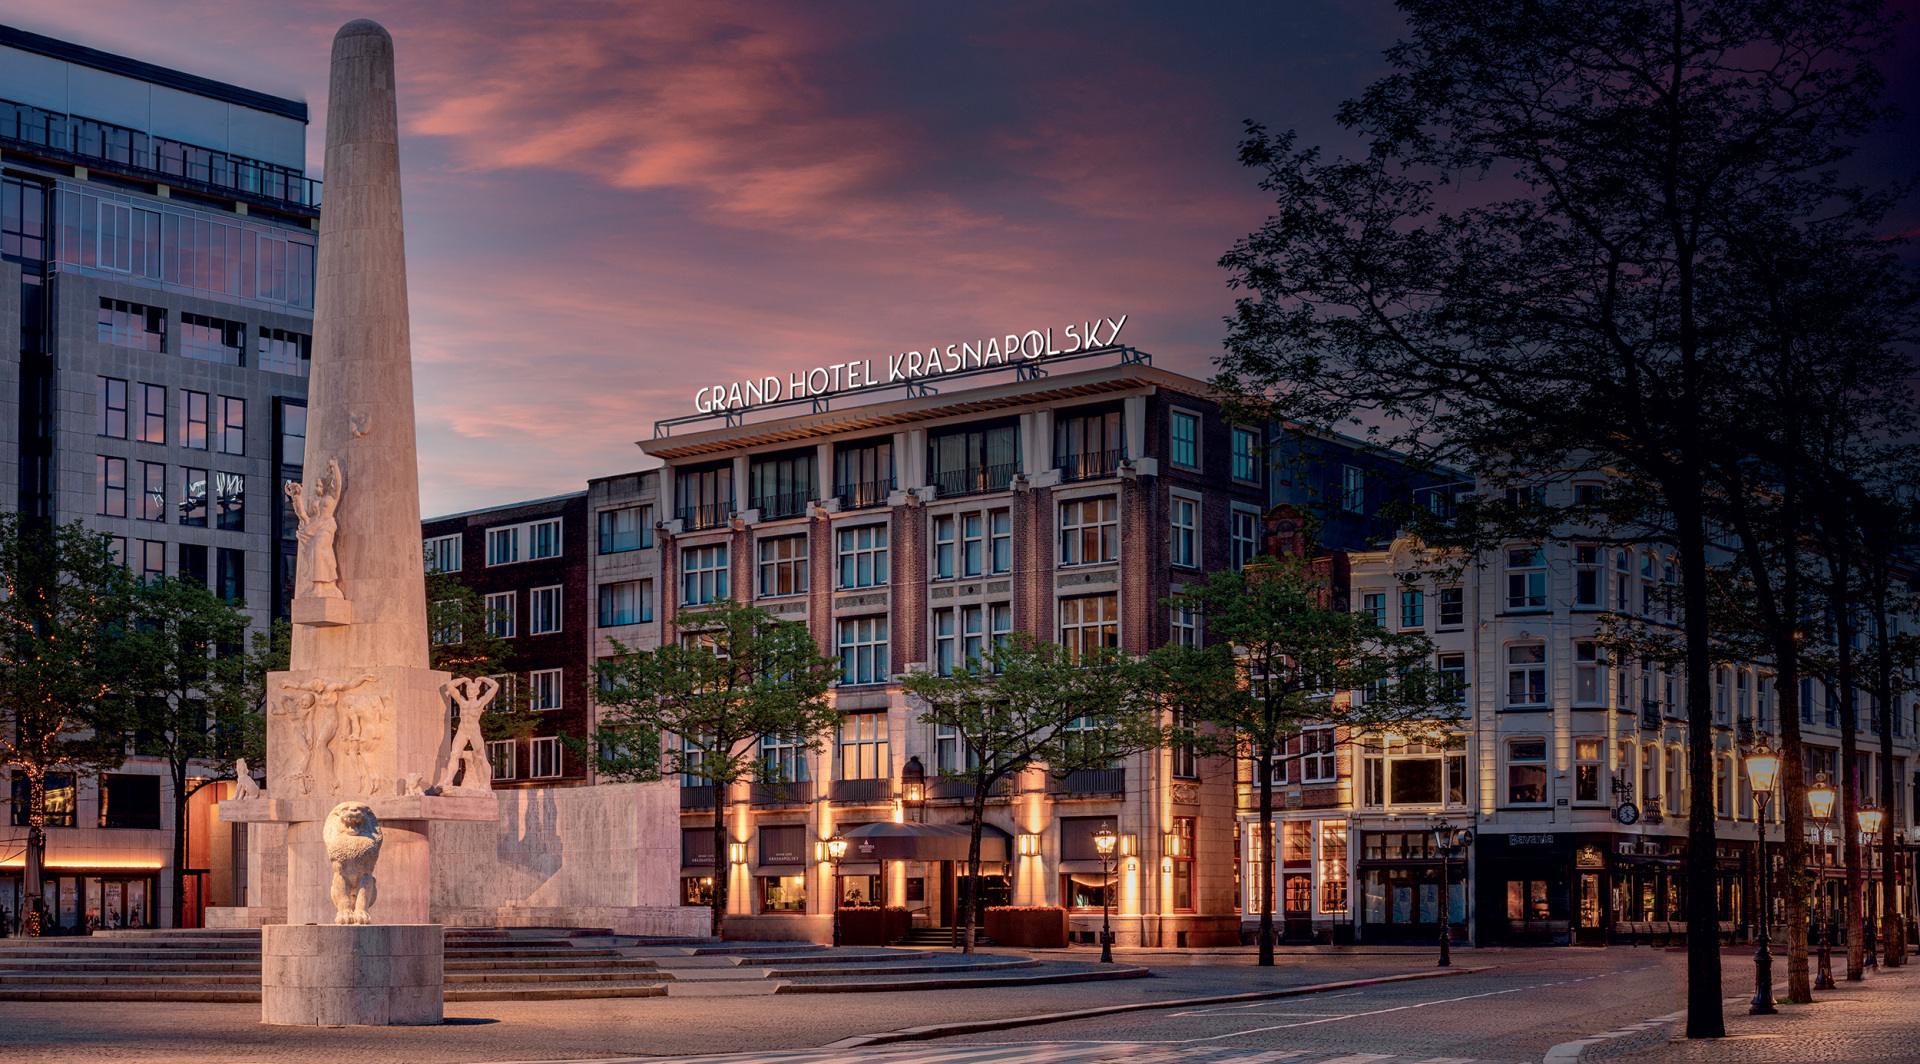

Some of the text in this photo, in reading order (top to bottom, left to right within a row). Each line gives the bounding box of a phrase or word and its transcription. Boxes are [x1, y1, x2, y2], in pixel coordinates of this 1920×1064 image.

[694, 314, 1128, 413] GRAND HOTEL KRASNAPOLSKY
